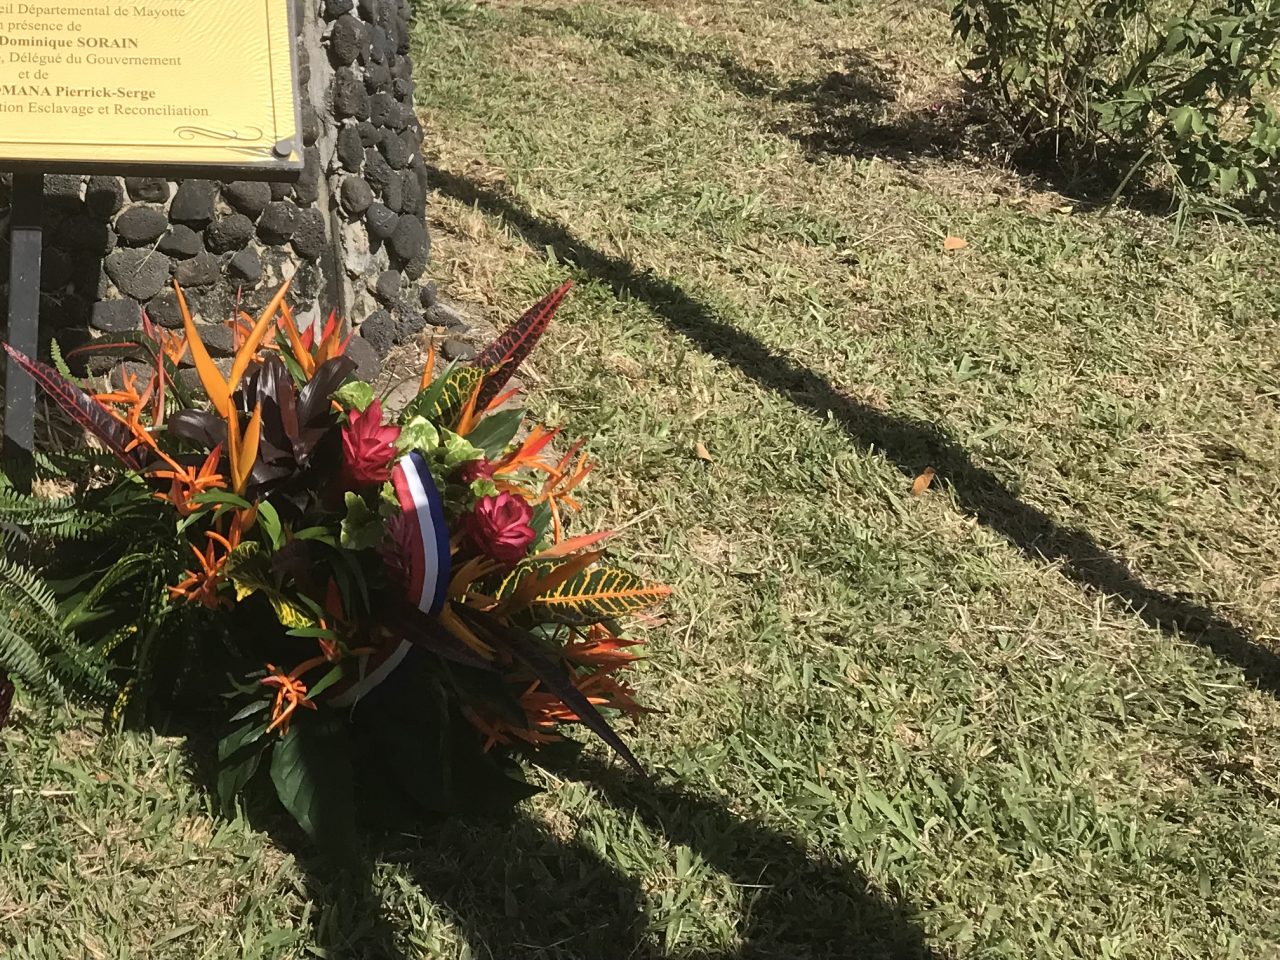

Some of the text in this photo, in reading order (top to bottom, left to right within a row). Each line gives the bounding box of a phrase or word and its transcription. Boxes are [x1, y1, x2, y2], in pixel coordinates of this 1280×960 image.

[18, 3, 110, 17] Départemental
[114, 6, 129, 16] de
[133, 6, 185, 19] Mayotte
[8, 20, 63, 32] présence
[67, 21, 82, 31] de
[0, 35, 73, 49] Dominique
[77, 37, 138, 48] SORAIN
[9, 51, 62, 65] Délégué
[66, 53, 81, 64] du
[86, 53, 181, 65] Gouvernement
[18, 69, 48, 80] et de
[56, 86, 156, 100] Pierrick-Serge
[28, 102, 94, 116] Esclavage
[98, 104, 109, 114] et
[114, 104, 209, 116] Reconciliation
